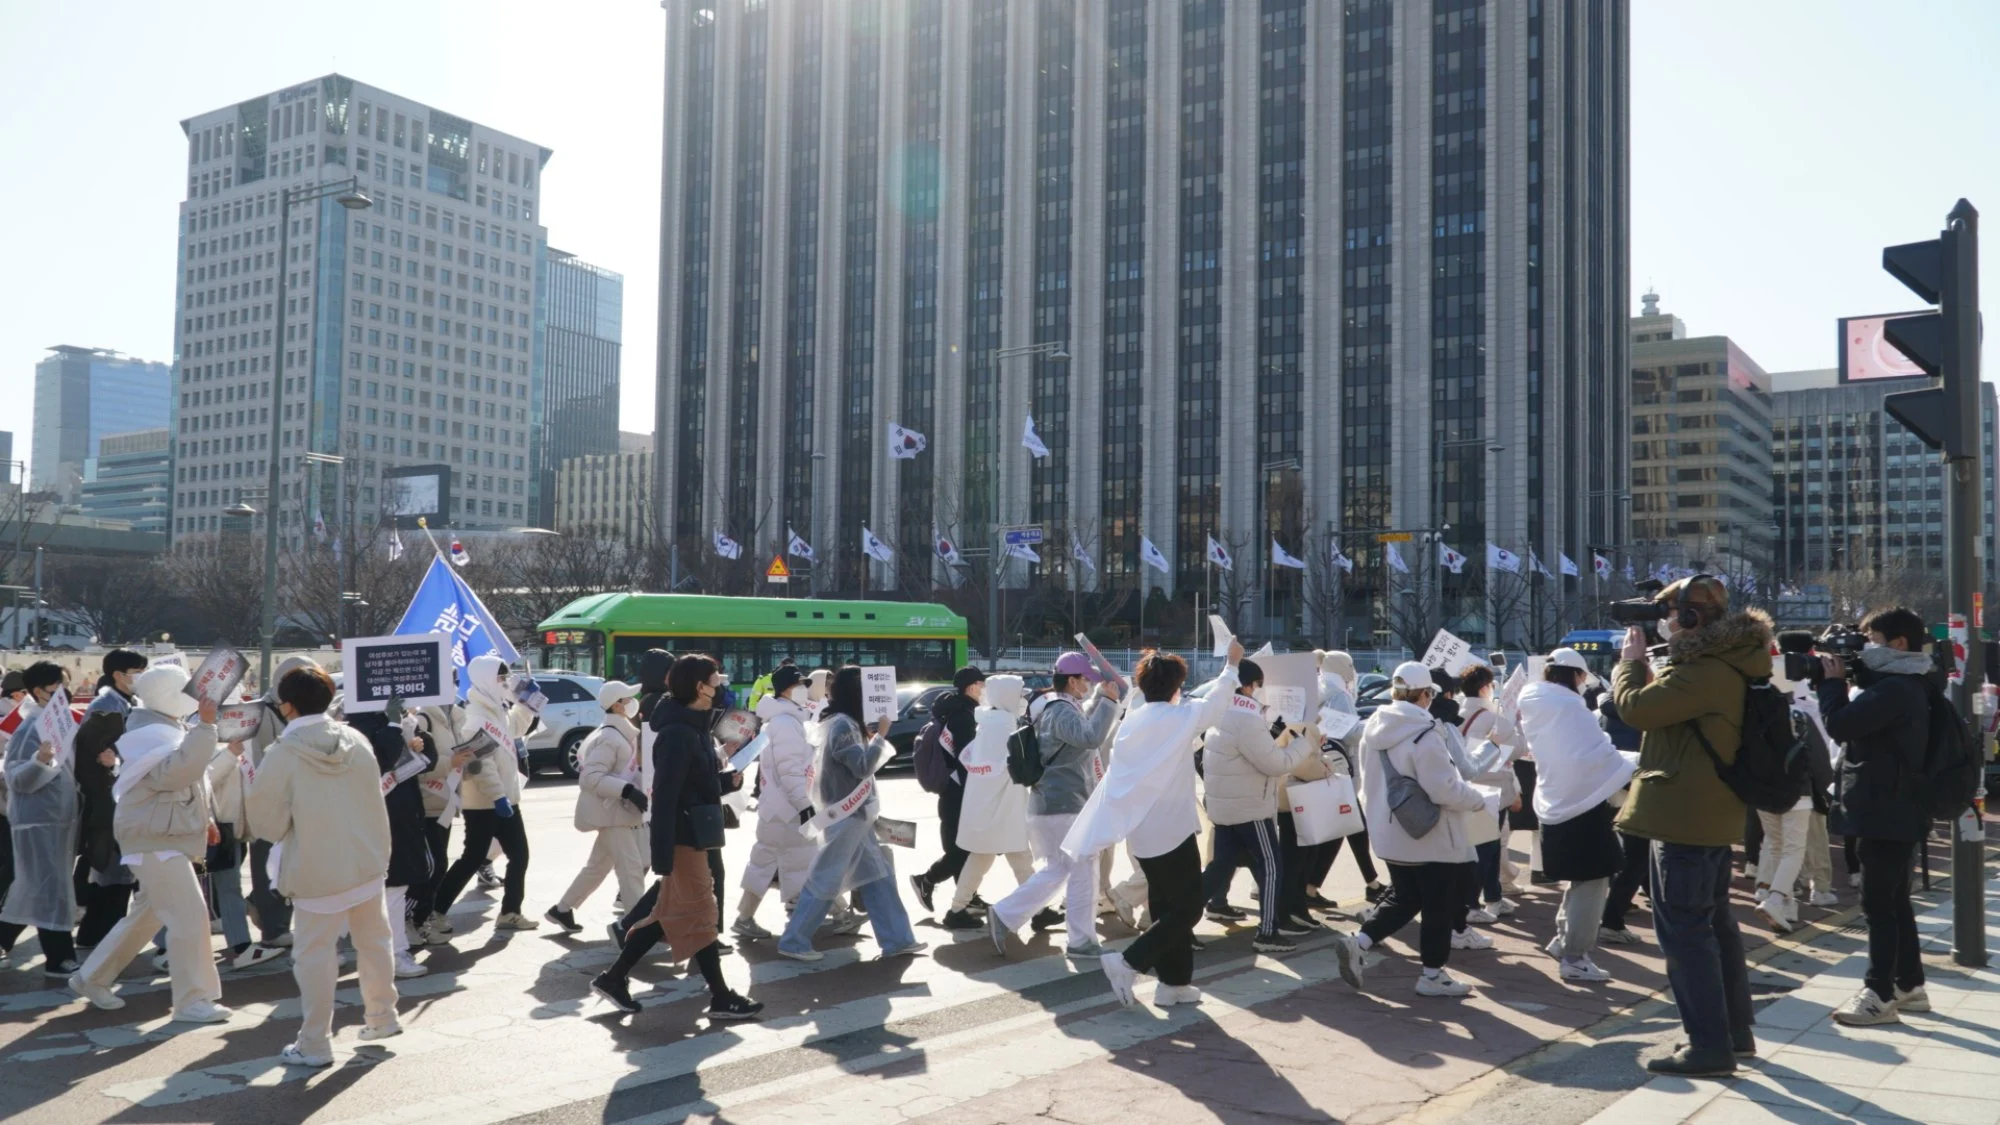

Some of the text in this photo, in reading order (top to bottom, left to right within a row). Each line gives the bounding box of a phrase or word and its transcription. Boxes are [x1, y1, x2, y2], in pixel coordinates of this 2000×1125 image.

[1573, 643, 1598, 651] 272
[372, 683, 425, 696] 없을 것이다
[1233, 696, 1257, 711] Vote
[484, 721, 502, 737] Vote
